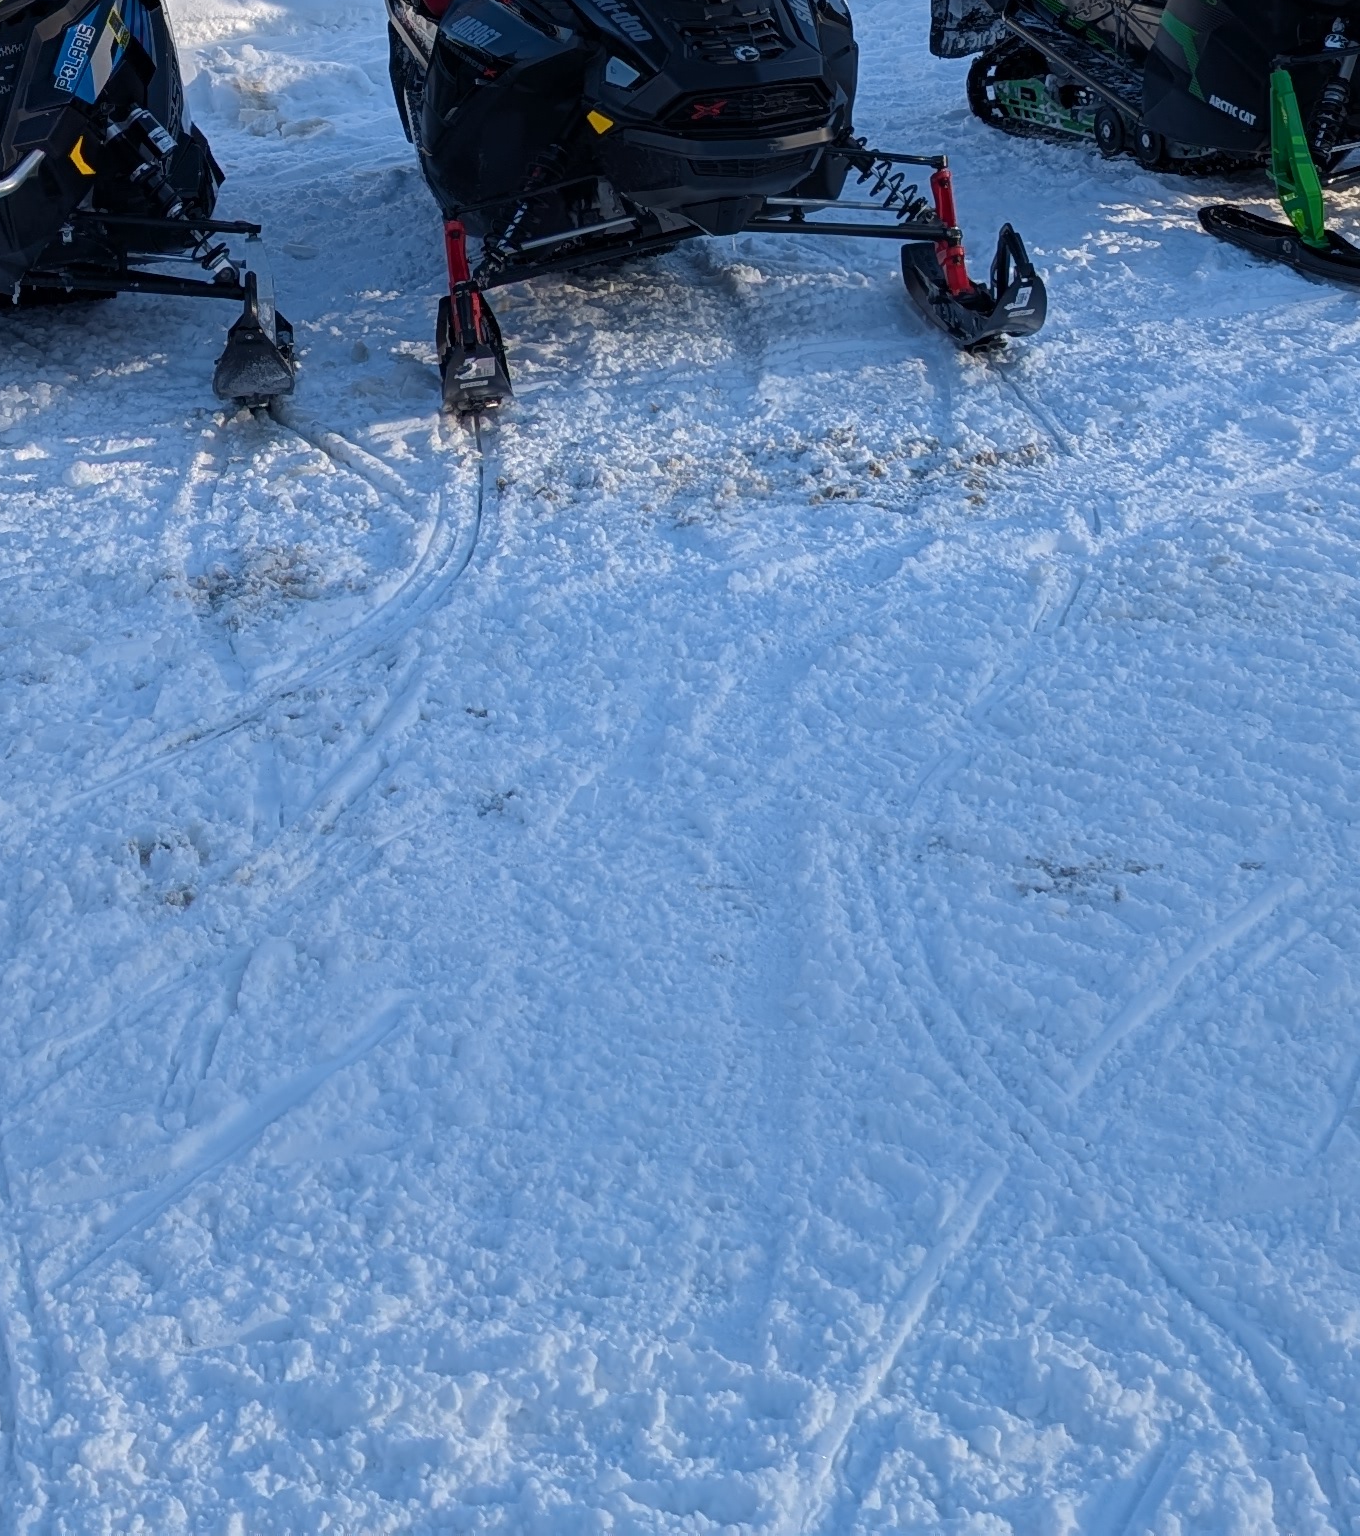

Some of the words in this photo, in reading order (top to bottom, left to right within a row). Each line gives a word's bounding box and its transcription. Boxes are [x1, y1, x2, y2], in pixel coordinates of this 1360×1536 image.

[53, 23, 96, 94] POLARIS
[1208, 94, 1239, 118] ARCTIC
[1238, 109, 1257, 126] CAT
